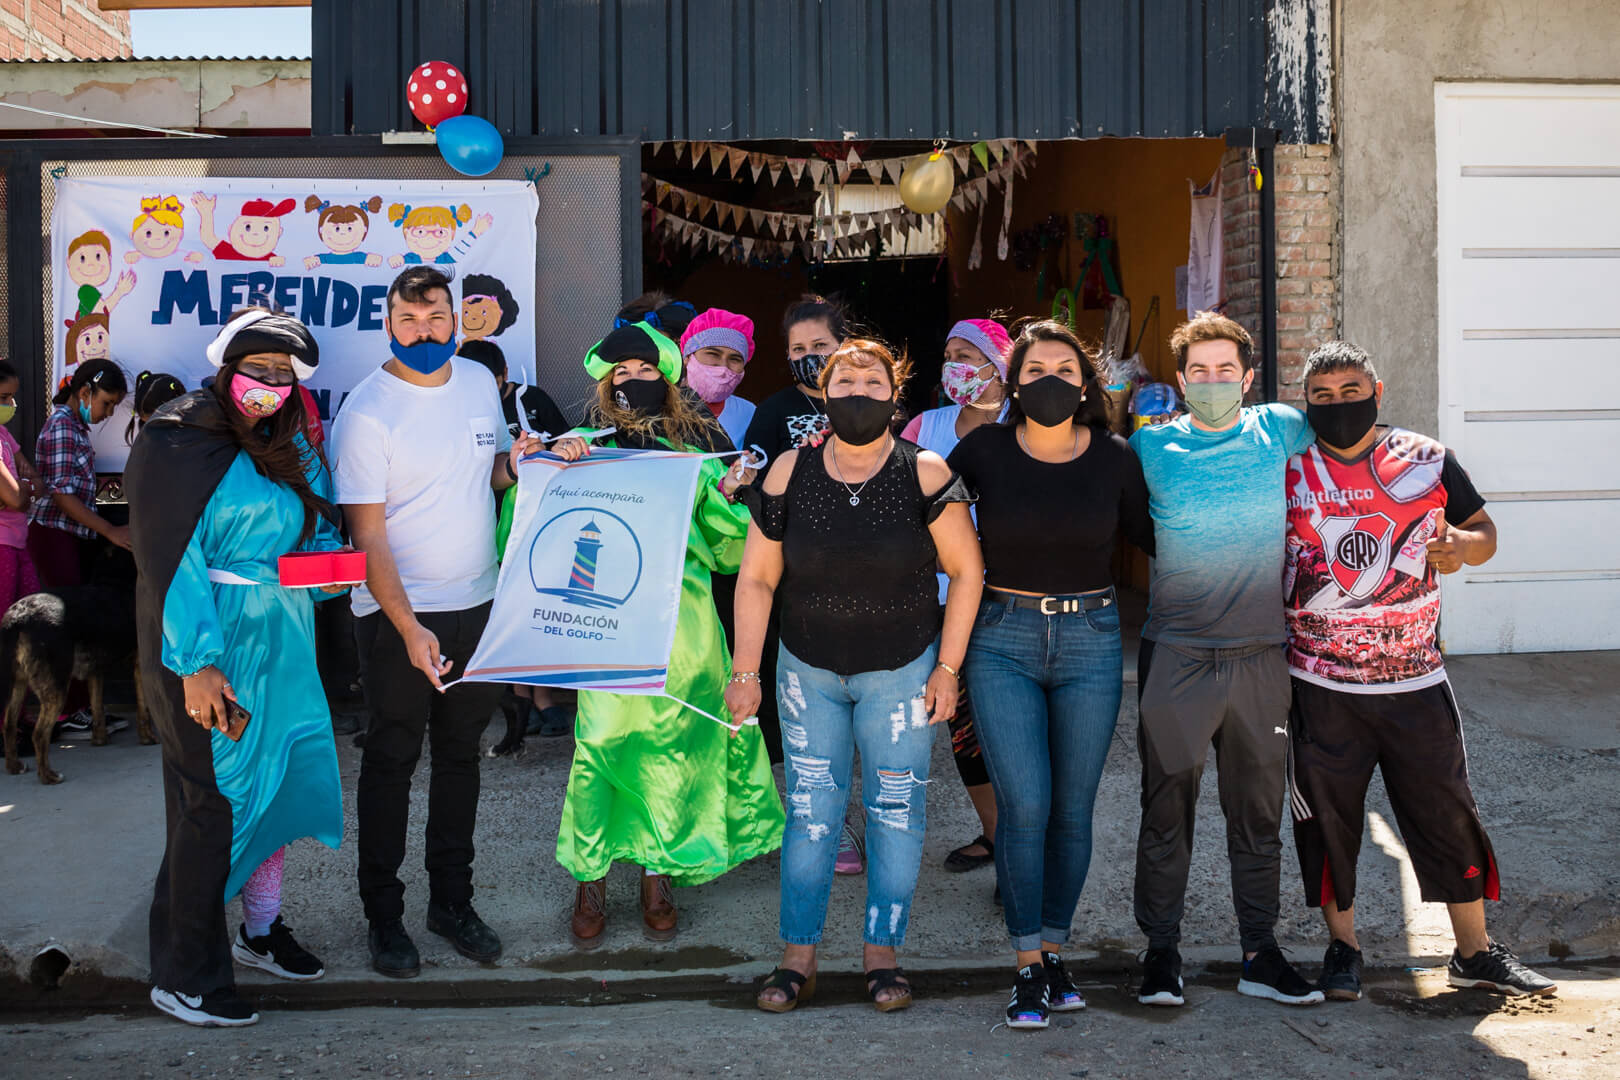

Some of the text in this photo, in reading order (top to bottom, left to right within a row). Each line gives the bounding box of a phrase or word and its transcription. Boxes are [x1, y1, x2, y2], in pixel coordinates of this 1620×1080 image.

[151, 269, 389, 331] MERENDE
[549, 485, 646, 504] Aquí acompaña
[533, 608, 619, 630] FUNDACIÓN
[544, 625, 604, 641] DEL GOLFO
